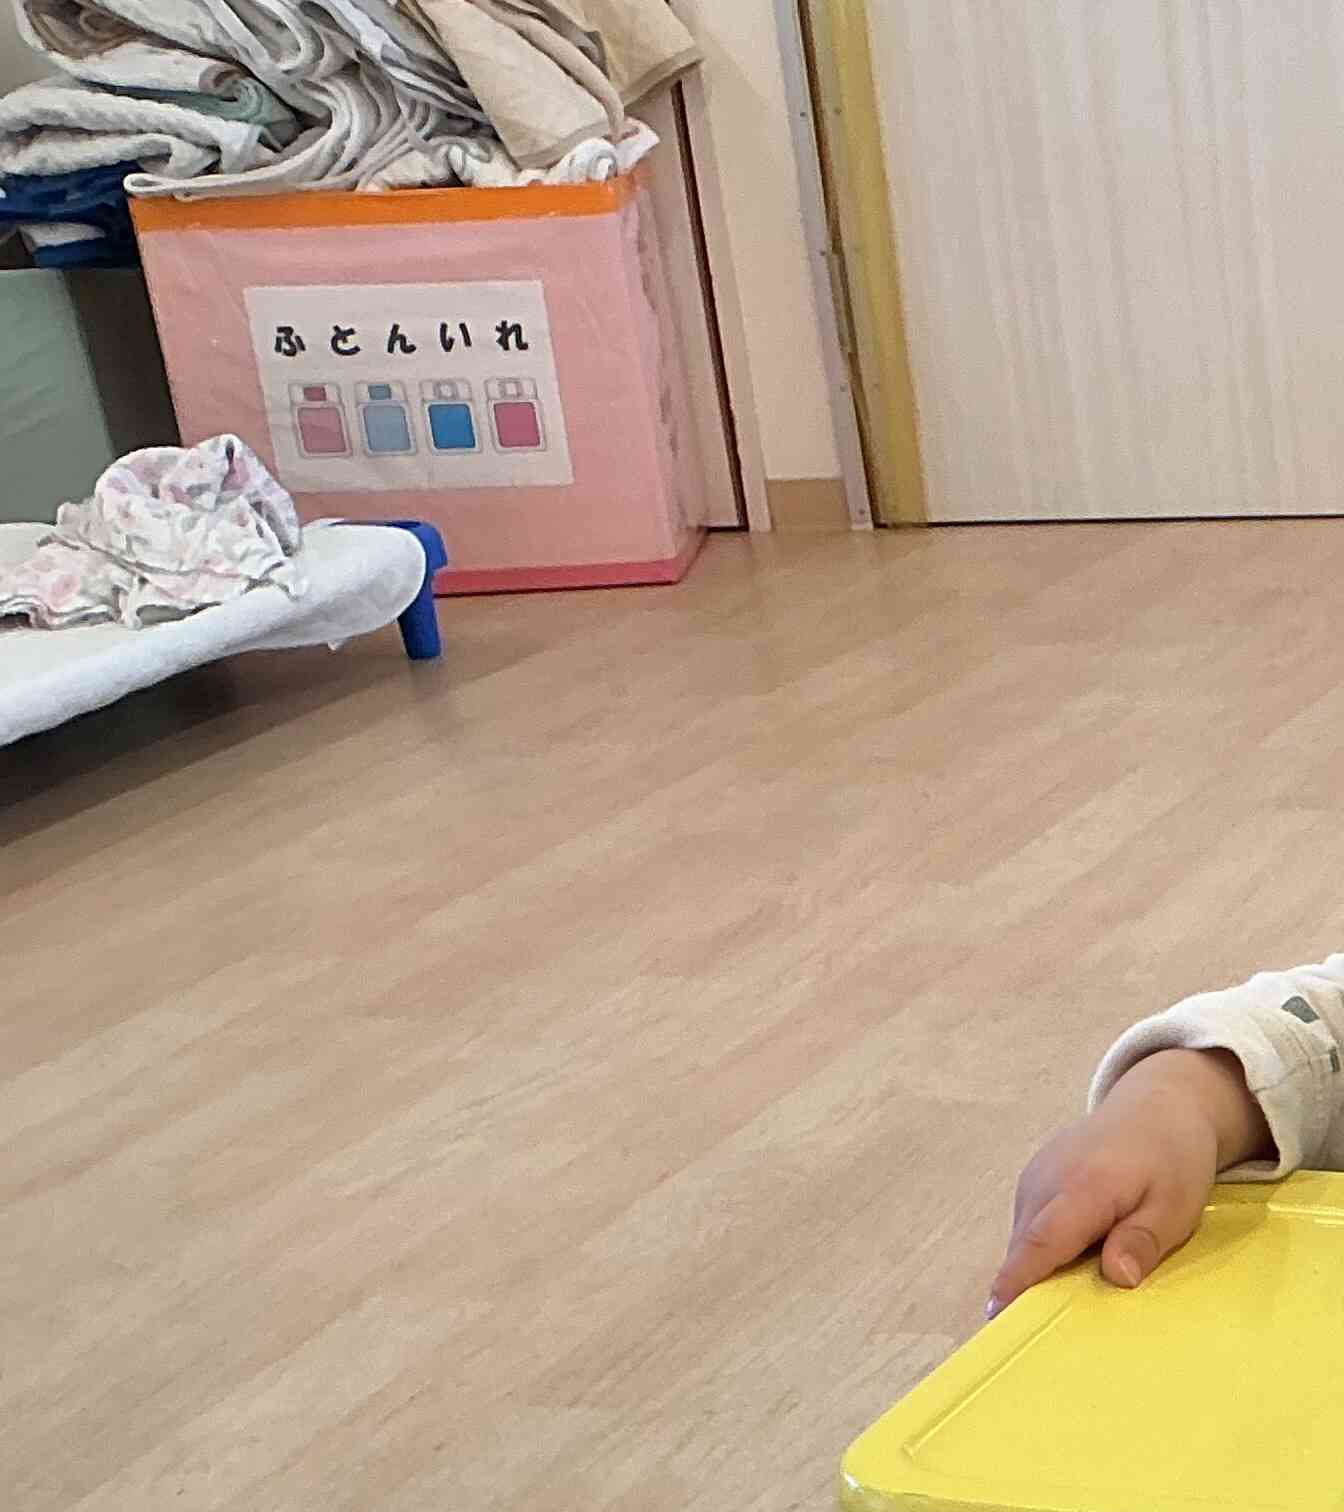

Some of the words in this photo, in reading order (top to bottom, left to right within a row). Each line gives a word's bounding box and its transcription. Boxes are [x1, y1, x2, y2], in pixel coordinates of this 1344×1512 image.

[274, 319, 529, 358] ふとんいれ
